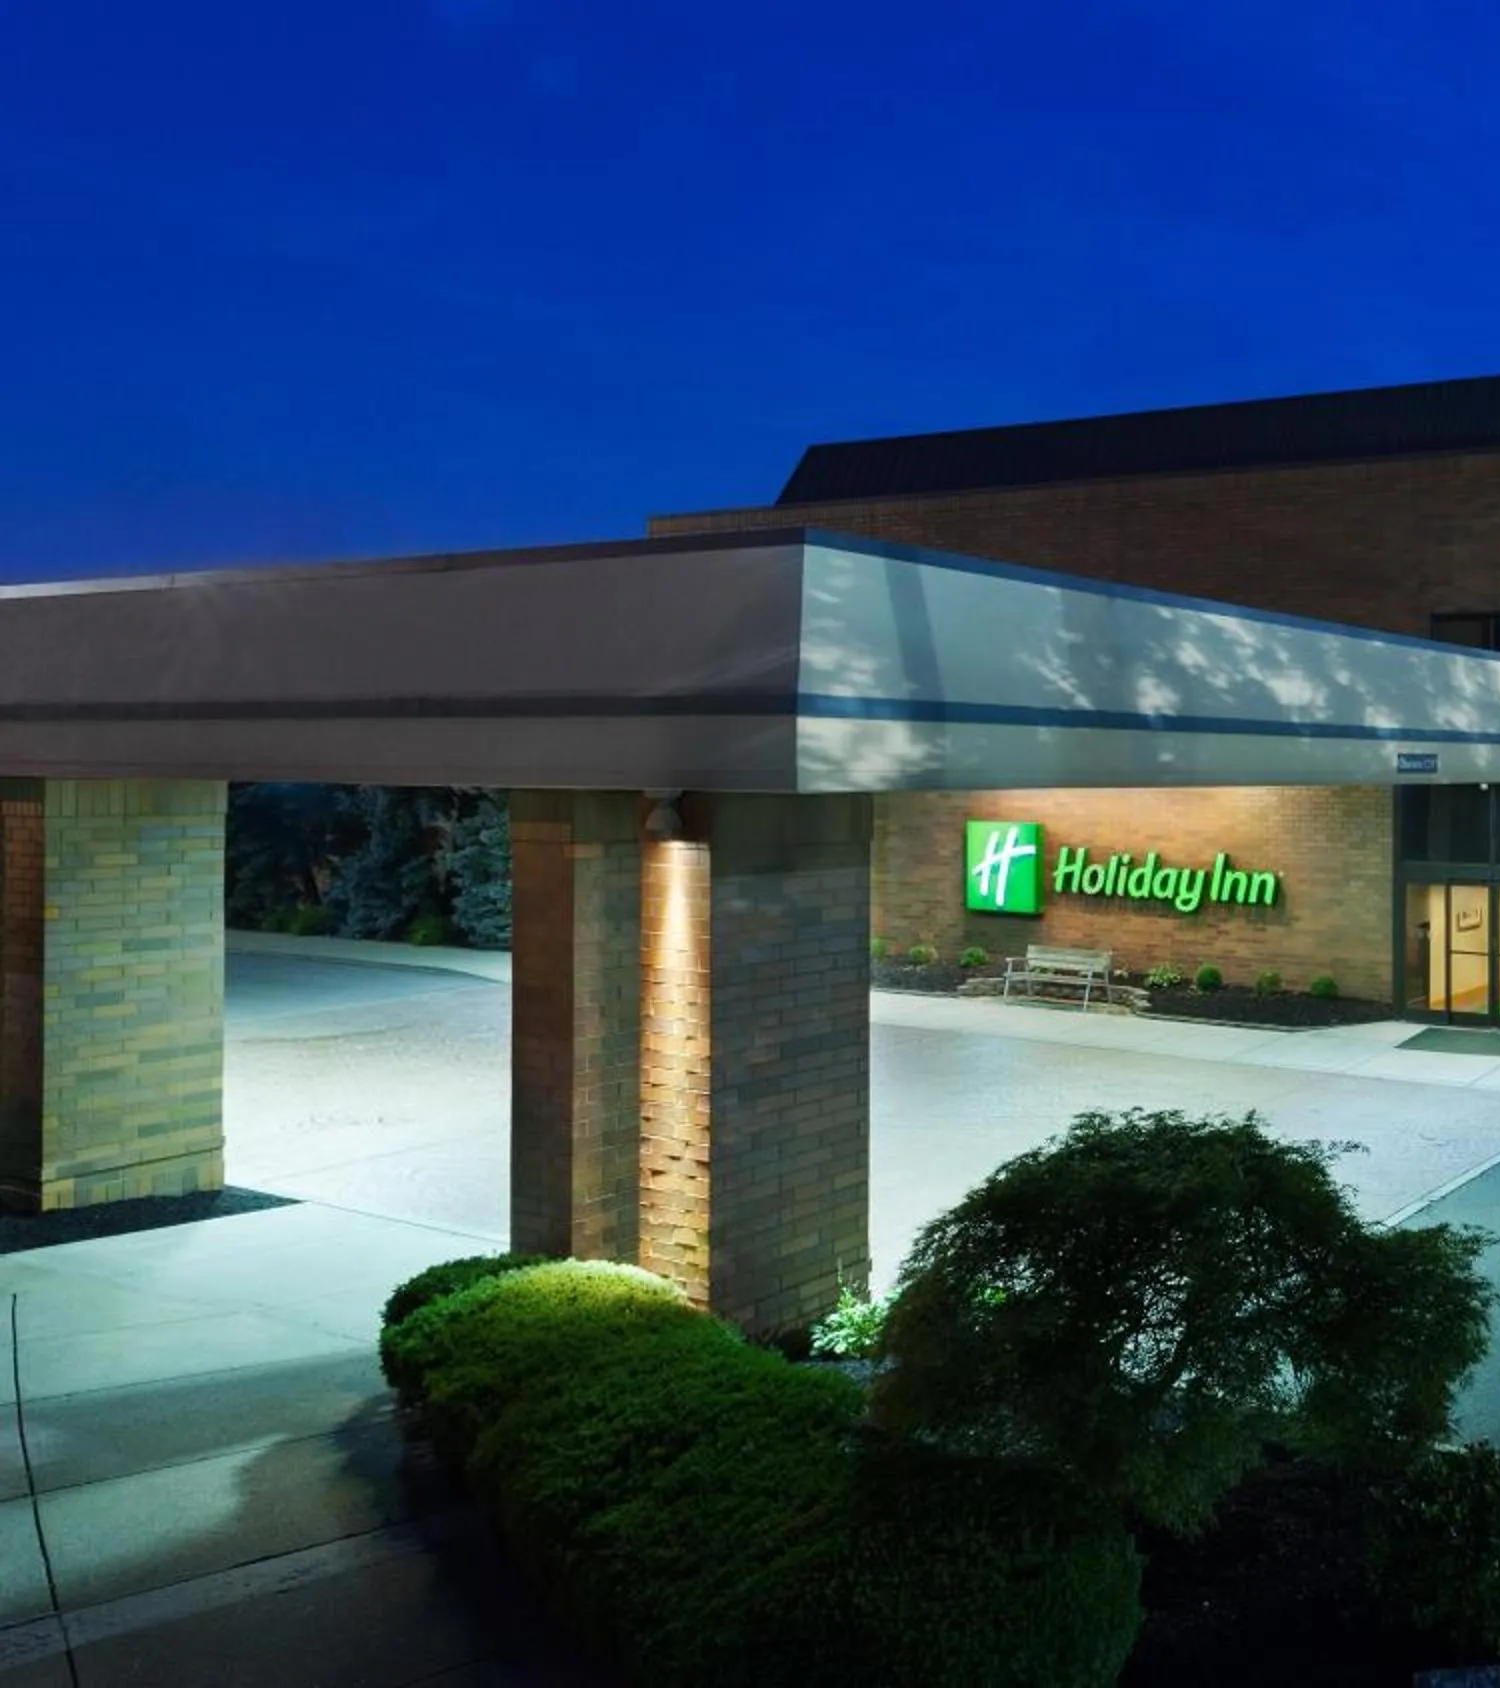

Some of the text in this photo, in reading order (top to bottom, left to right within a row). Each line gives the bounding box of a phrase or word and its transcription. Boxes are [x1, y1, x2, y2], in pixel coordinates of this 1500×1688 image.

[971, 827, 1037, 906] H
[1053, 846, 1277, 912] Holiday Inn
